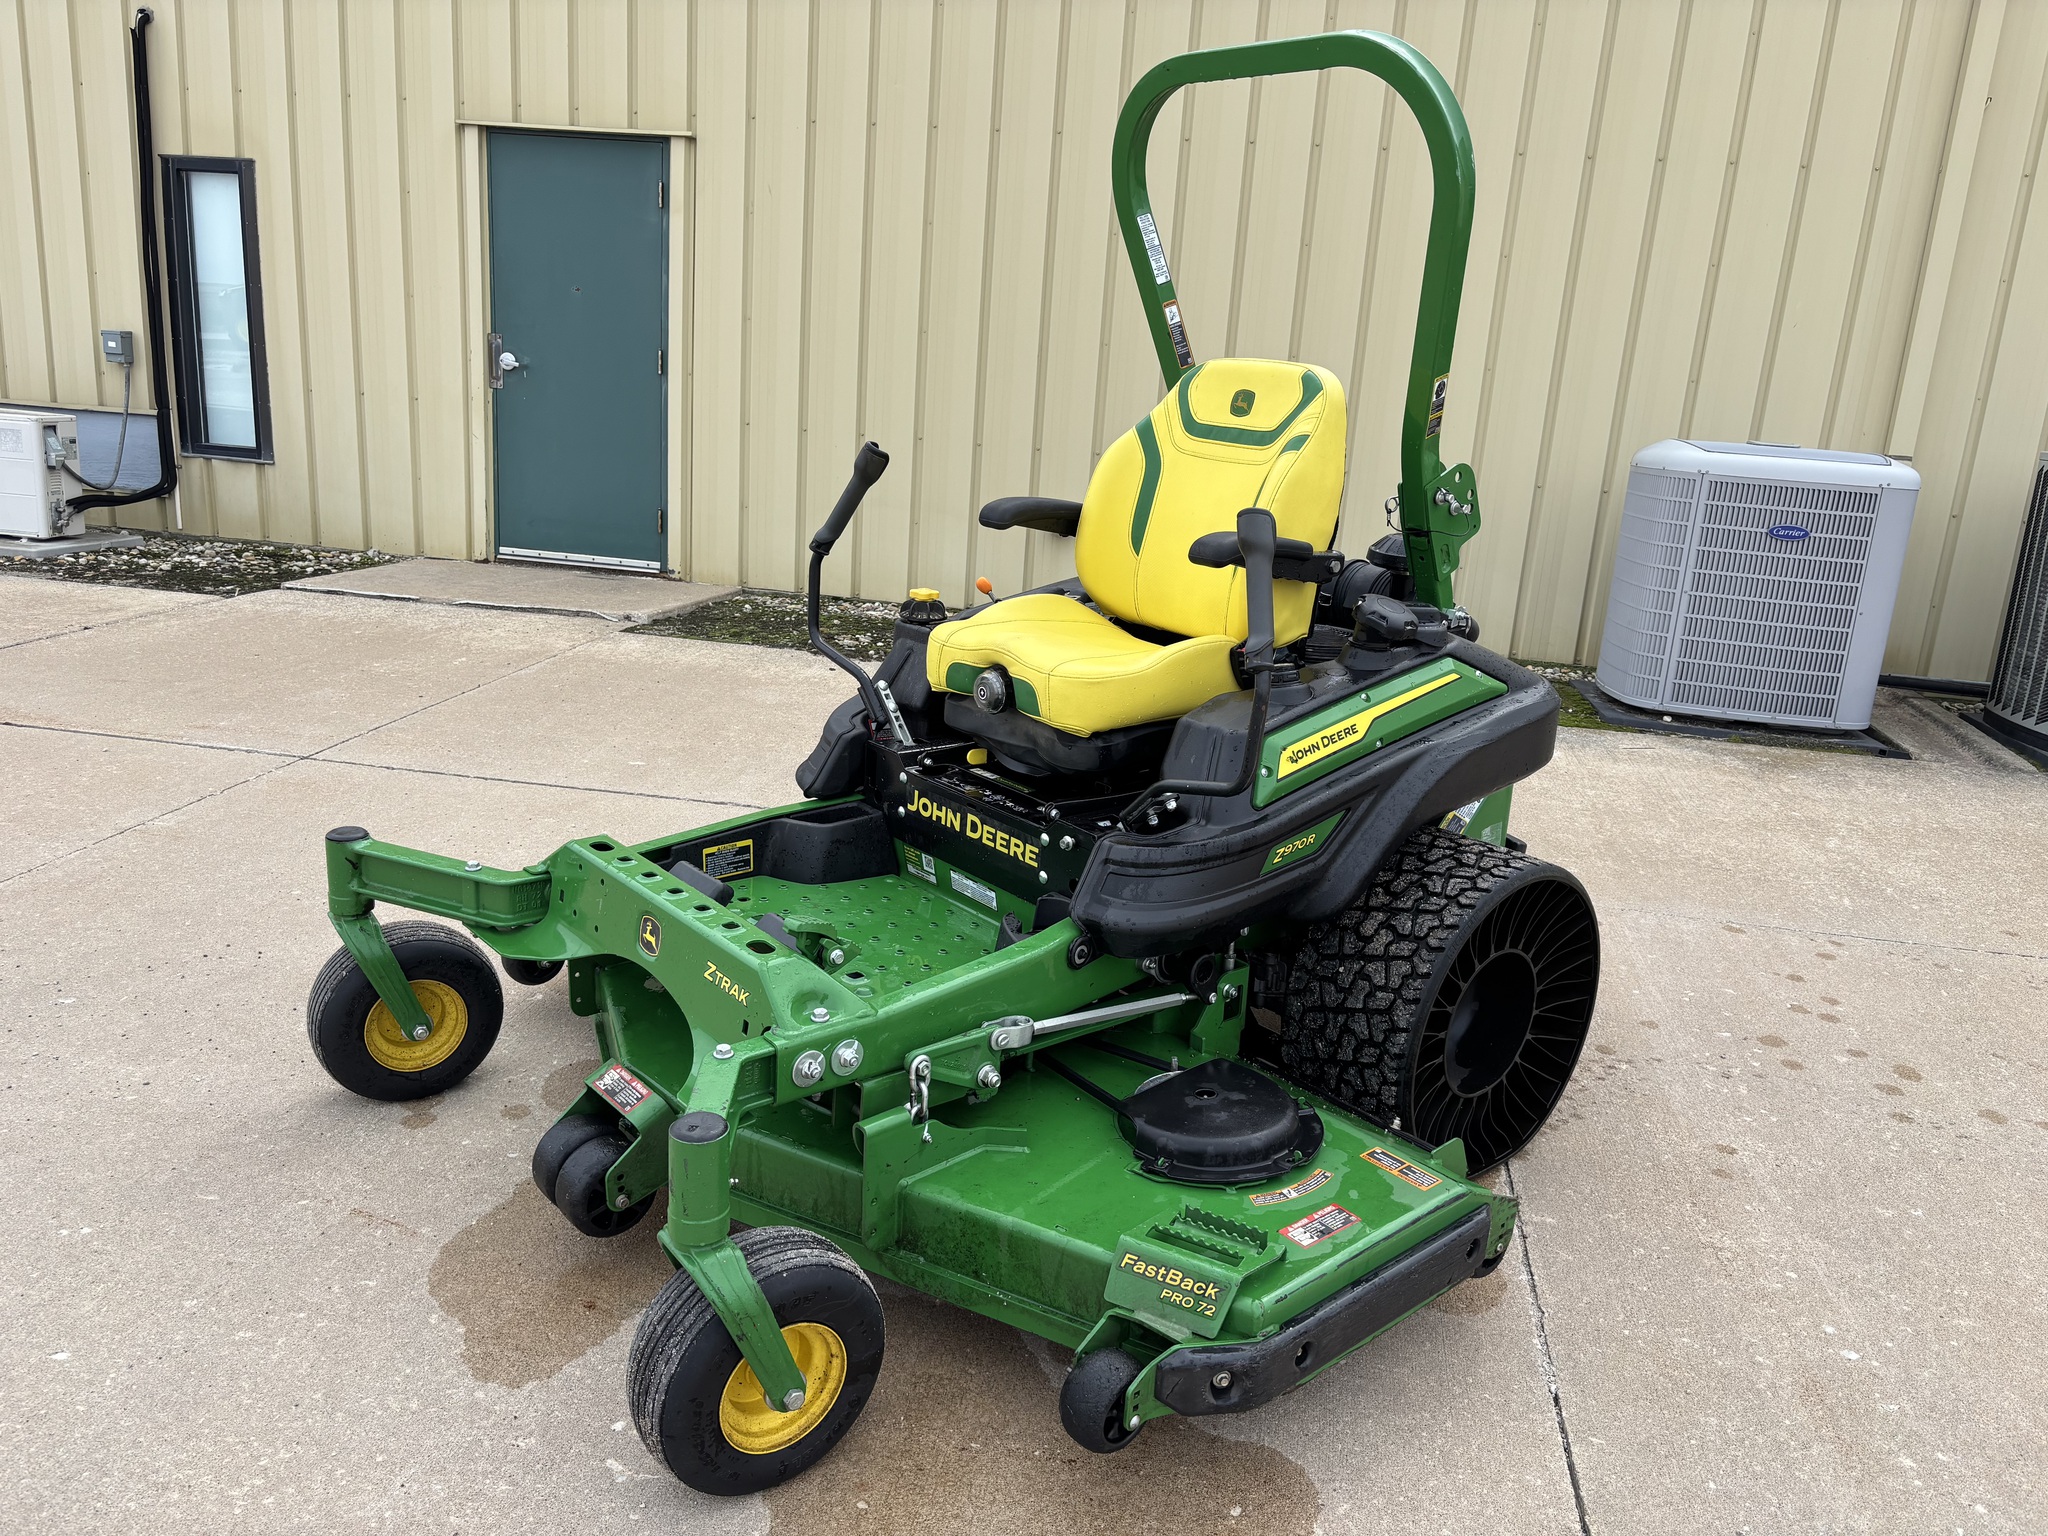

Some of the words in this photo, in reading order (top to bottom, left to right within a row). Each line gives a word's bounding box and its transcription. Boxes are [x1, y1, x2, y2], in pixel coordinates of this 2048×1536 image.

[1773, 527, 1806, 537] Carrier
[1289, 741, 1320, 764] JOHN
[1321, 724, 1359, 749] DEERE
[907, 790, 961, 832] JOHN
[966, 813, 1039, 868] DEERE
[1272, 833, 1316, 864] Z970R
[703, 961, 750, 1007] ZTRAK
[1120, 1253, 1220, 1300] FastBack
[1160, 1289, 1194, 1308] PRO
[1196, 1301, 1216, 1317] 72
